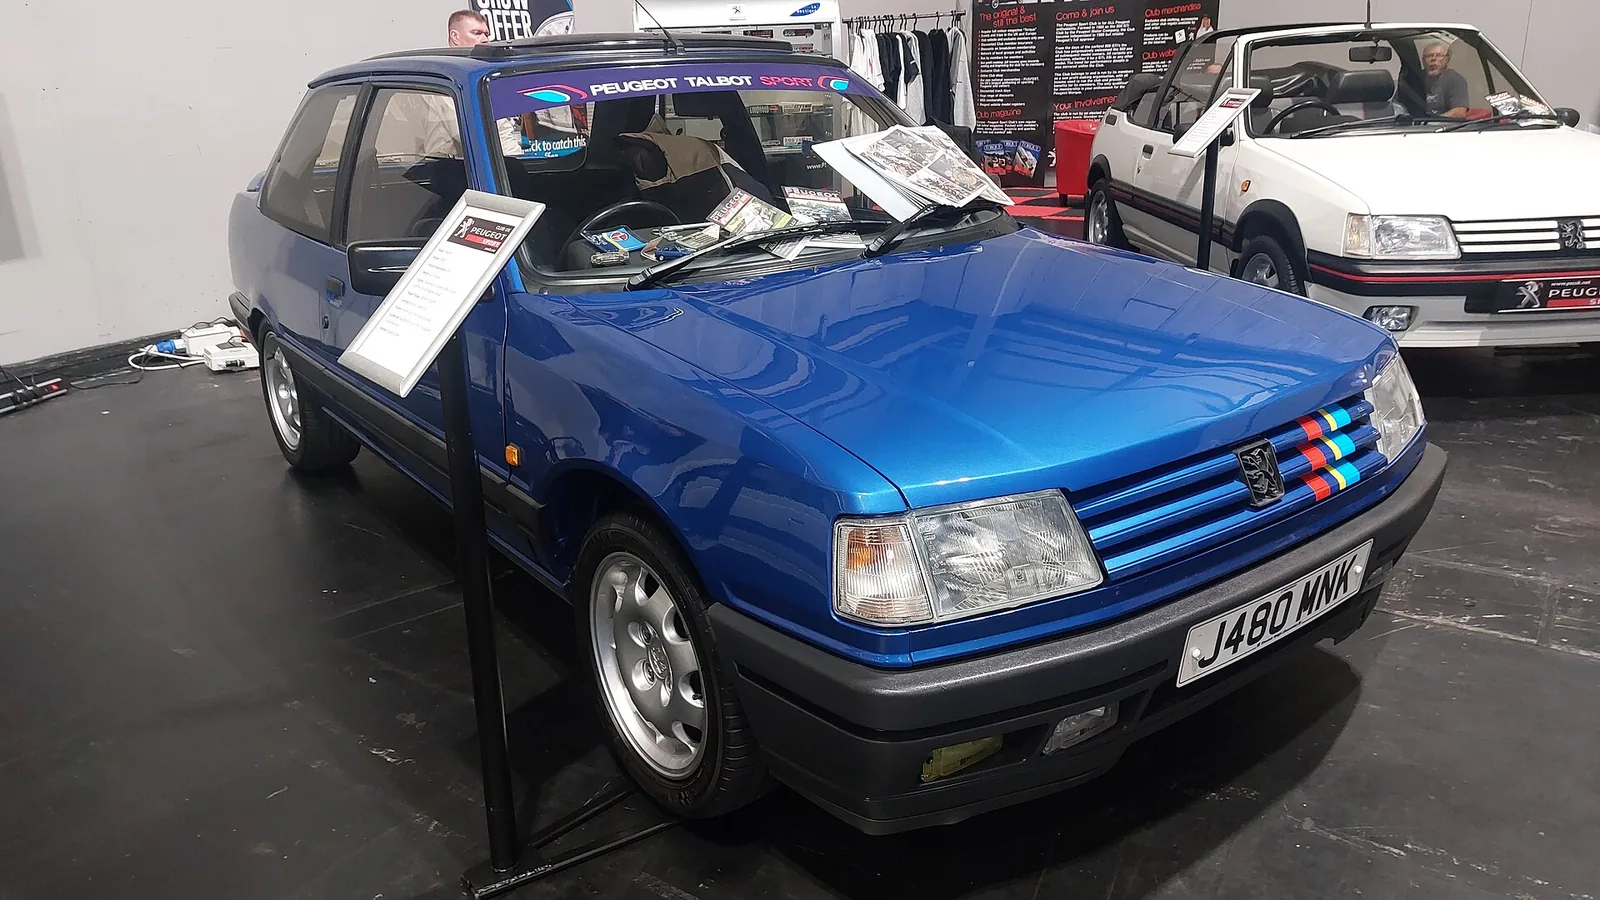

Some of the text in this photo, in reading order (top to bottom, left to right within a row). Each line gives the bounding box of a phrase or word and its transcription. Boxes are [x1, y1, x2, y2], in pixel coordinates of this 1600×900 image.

[980, 6, 1026, 21] The original &
[1056, 6, 1116, 20] Come & join us
[1144, 3, 1202, 17] Club merchandise
[479, 9, 534, 41] OFFER
[993, 12, 1037, 28] still the best
[1142, 51, 1158, 60] Club
[590, 76, 813, 96] PEUGEOT TALBOT SPORT
[976, 107, 1022, 119] Club magazine
[1053, 102, 1072, 111] Your
[542, 140, 552, 151] to
[552, 137, 573, 150] catch
[573, 134, 587, 148] this
[784, 187, 840, 198] PEUGEOT
[712, 190, 744, 221] PEUGEOT
[471, 226, 507, 240] PEUGEOT
[1548, 287, 1600, 298] PEUG
[1198, 553, 1358, 669] J480 MNK
